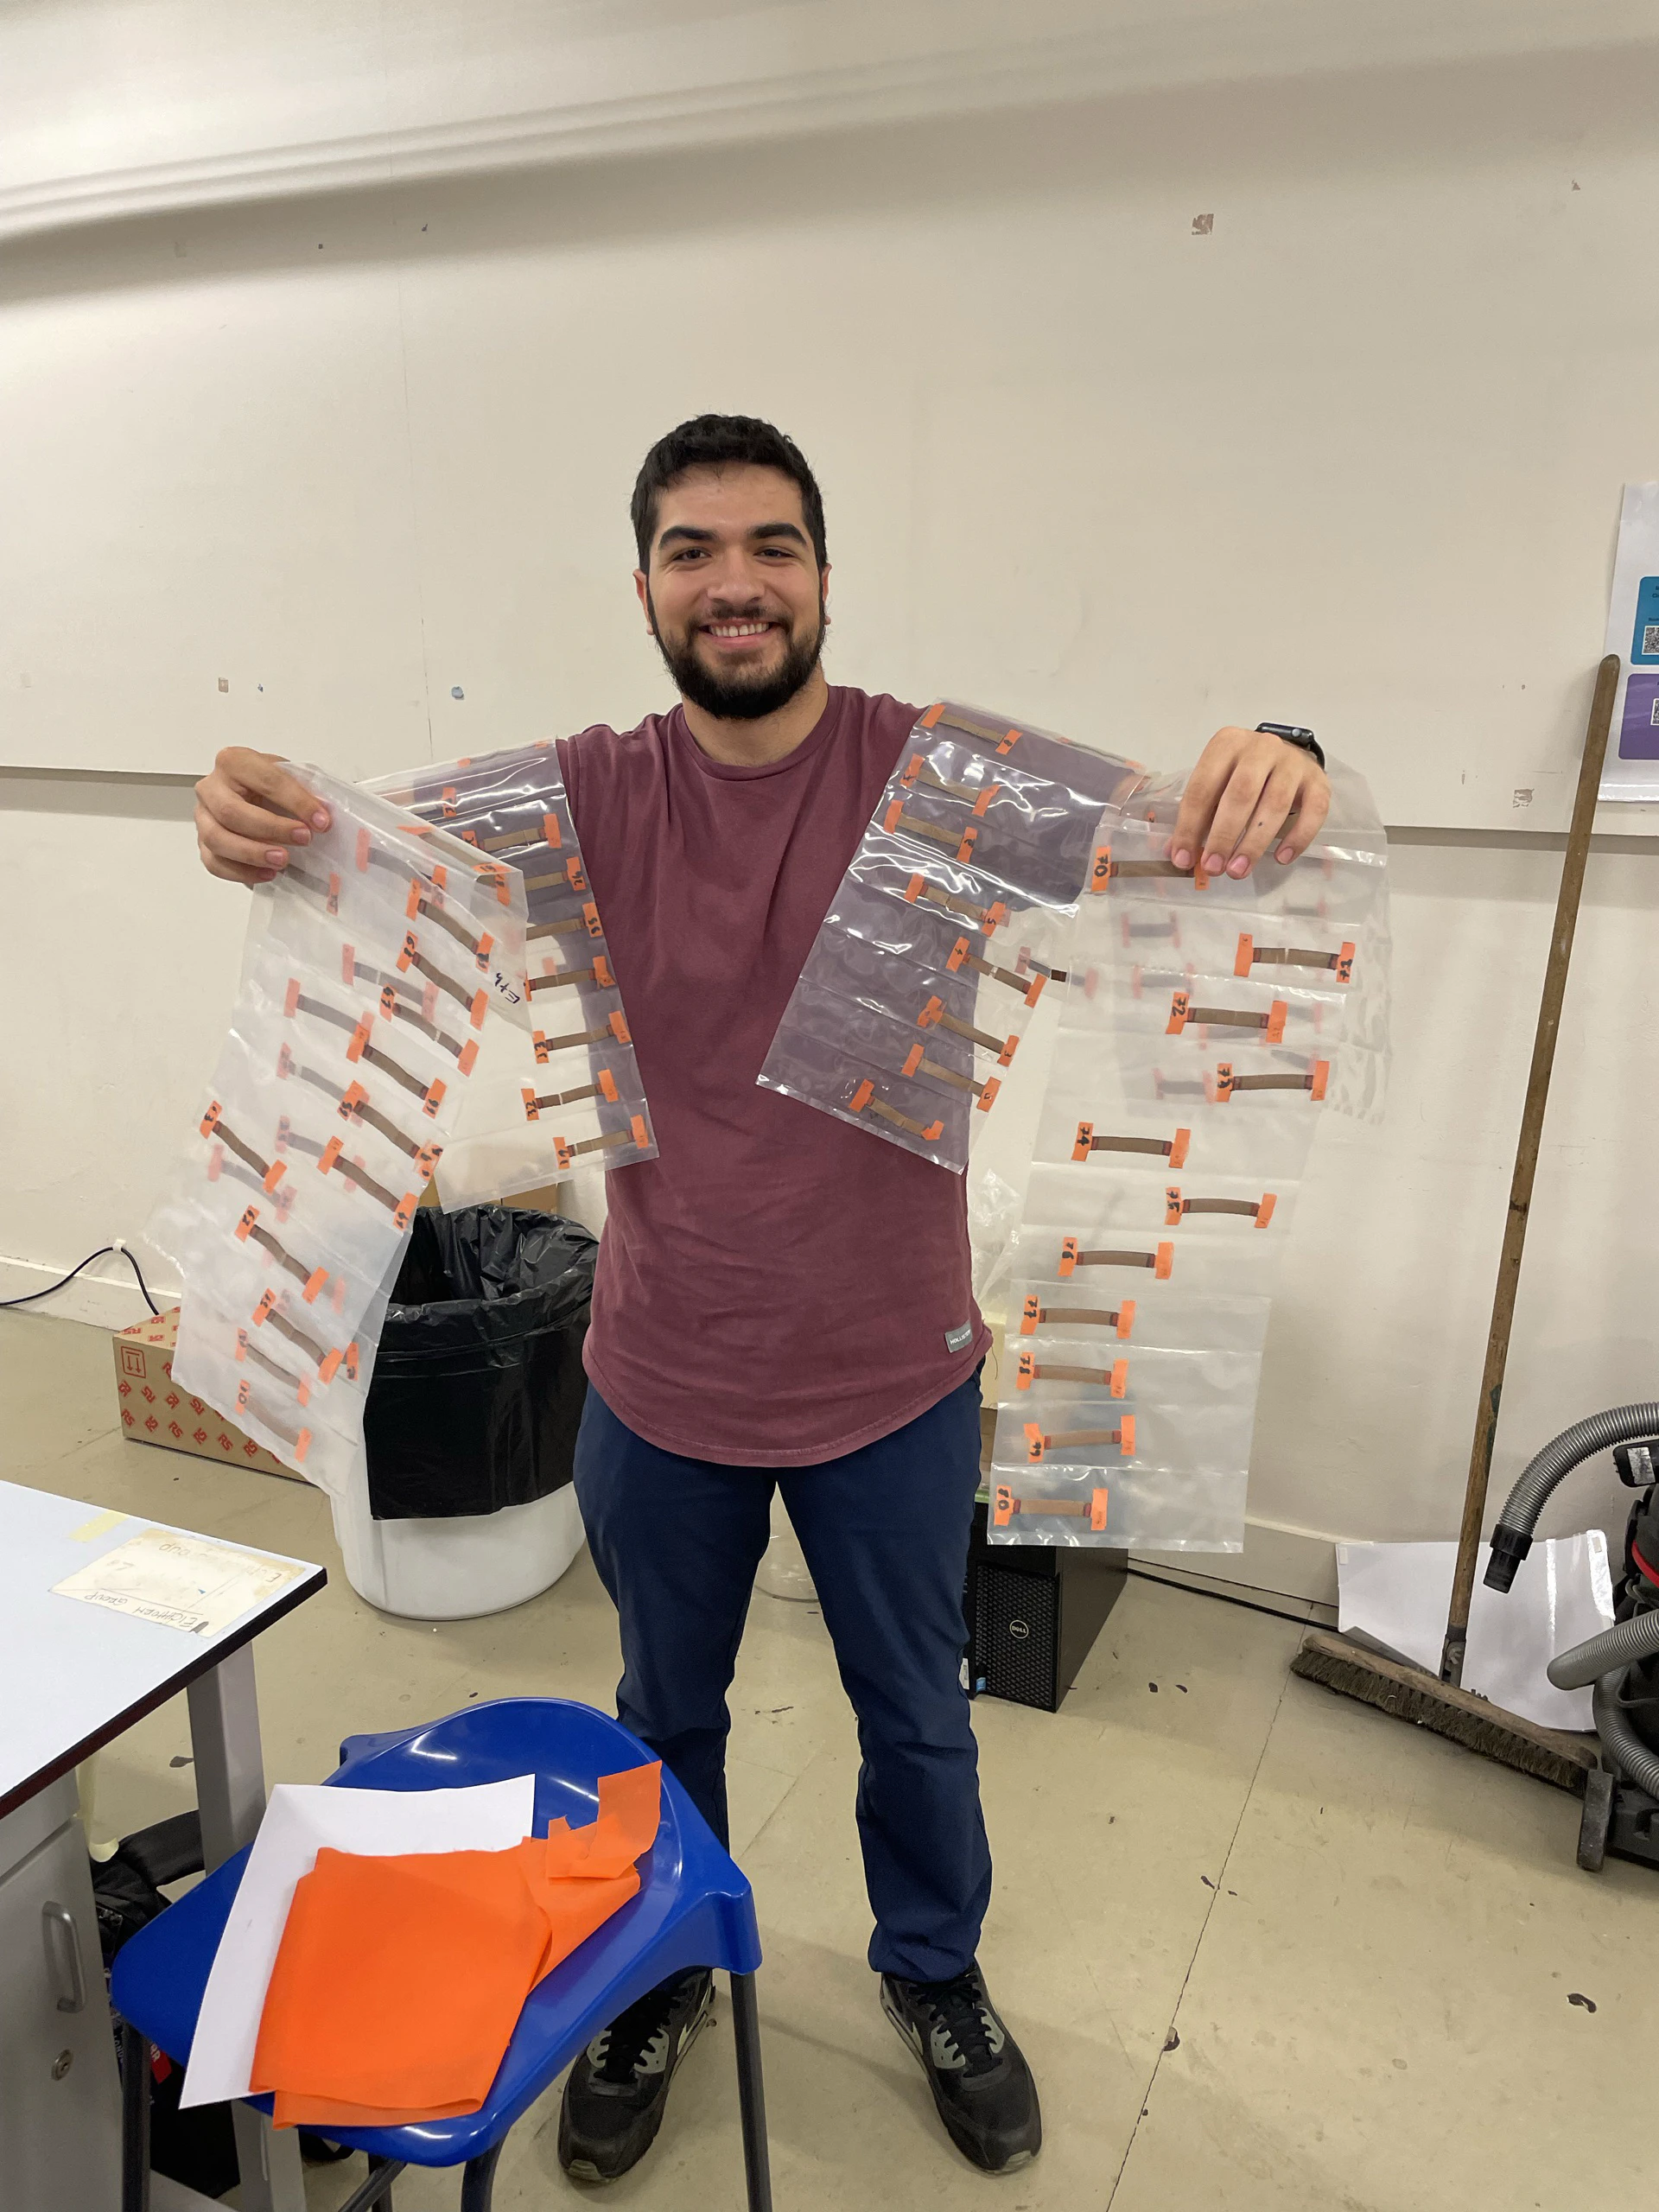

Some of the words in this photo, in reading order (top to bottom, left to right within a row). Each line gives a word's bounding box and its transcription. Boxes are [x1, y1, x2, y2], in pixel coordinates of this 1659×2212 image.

[1095, 854, 1109, 877] 70
[1172, 997, 1186, 1017] 72
[1077, 1126, 1090, 1146] 74
[121, 1408, 135, 1427] RS
[168, 1421, 183, 1439] RS
[218, 1433, 233, 1452] RS
[1011, 1625, 1027, 1634] DELL
